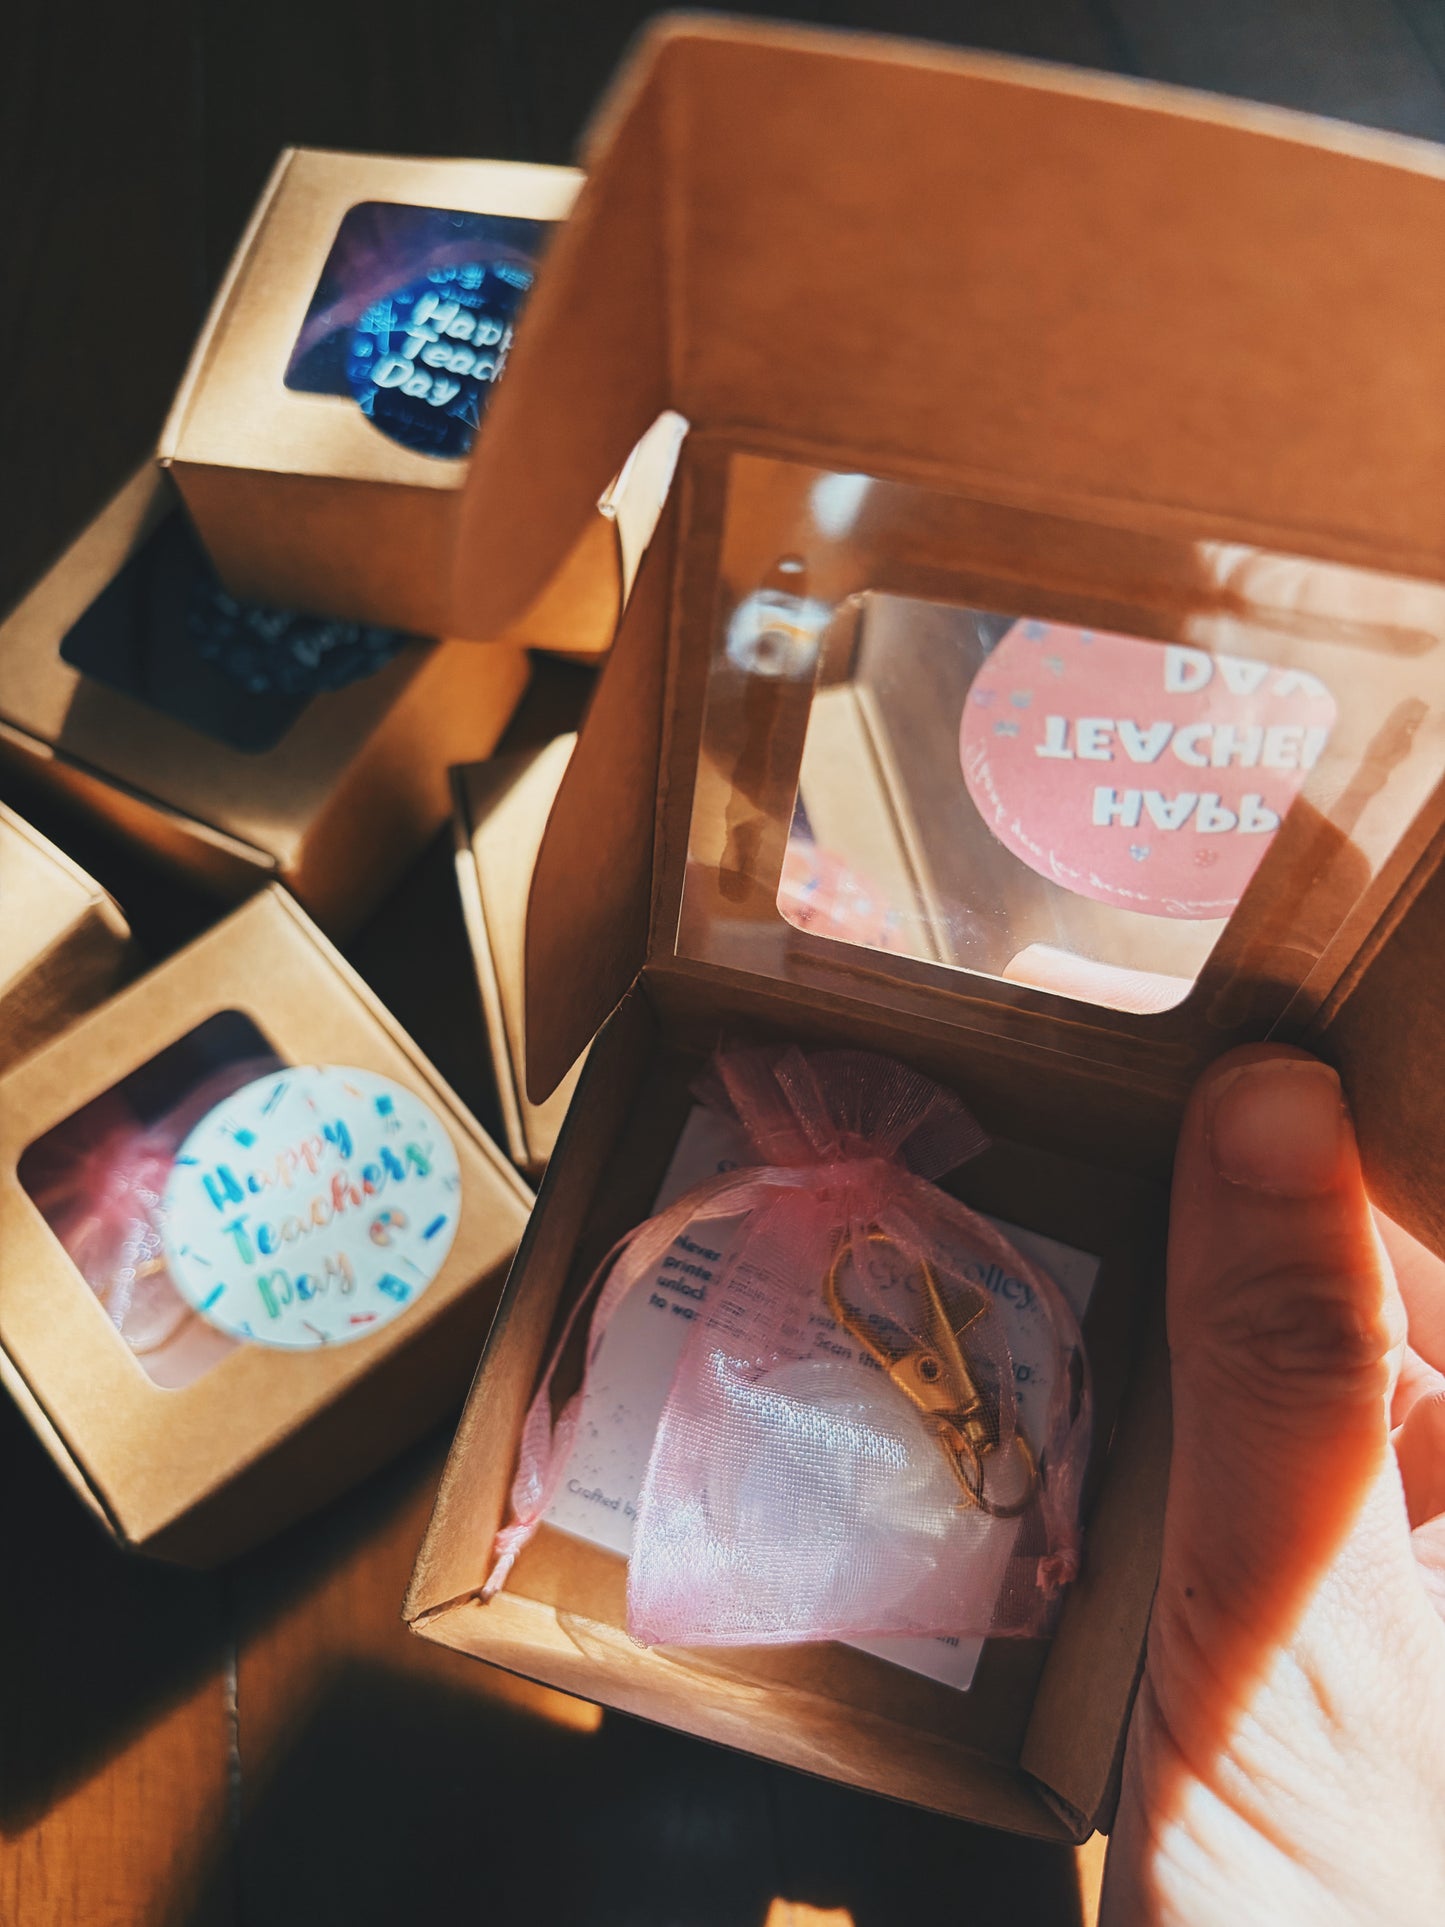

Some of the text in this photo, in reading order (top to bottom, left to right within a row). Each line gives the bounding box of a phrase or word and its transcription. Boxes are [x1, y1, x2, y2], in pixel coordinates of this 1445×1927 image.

[371, 351, 461, 407] Day
[201, 1117, 353, 1213] Happy
[257, 1251, 357, 1319] Day
